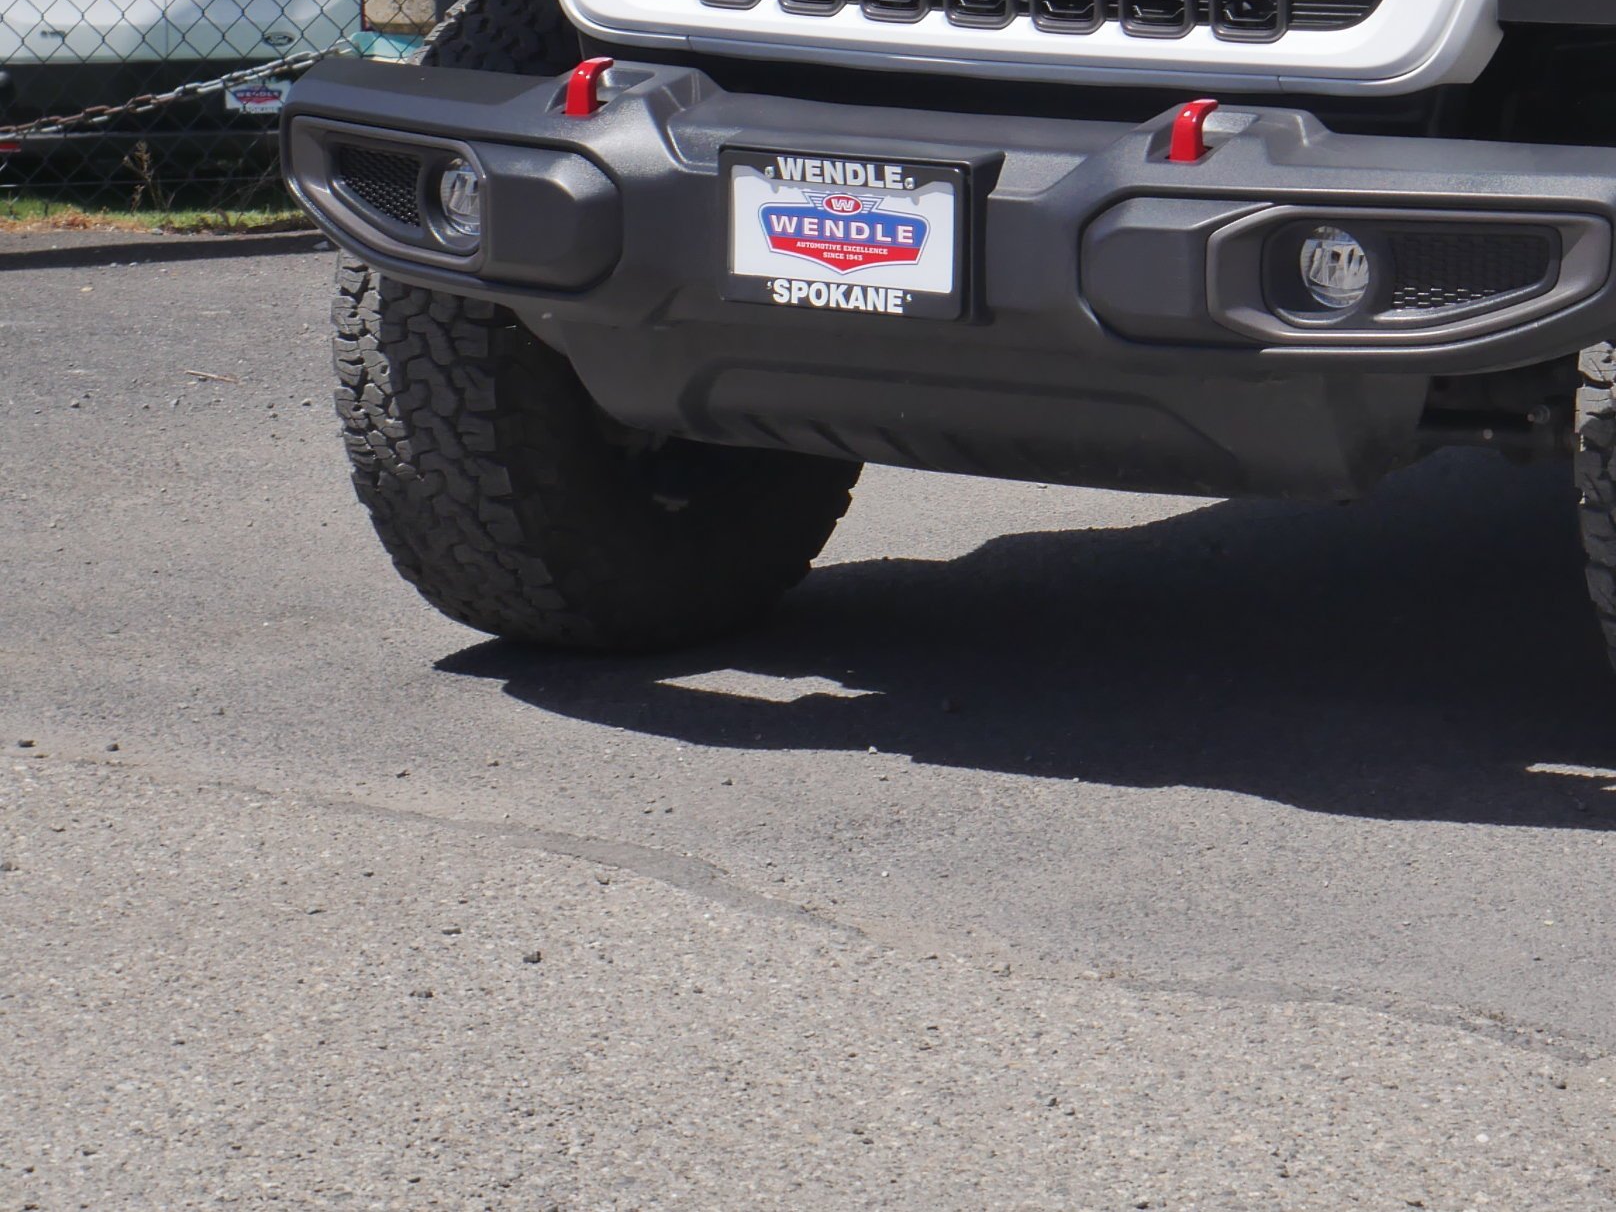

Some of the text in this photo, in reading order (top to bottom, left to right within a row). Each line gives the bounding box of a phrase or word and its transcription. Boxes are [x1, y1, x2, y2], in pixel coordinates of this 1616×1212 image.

[777, 156, 904, 190] WENDLE
[770, 214, 914, 244] WENDLE
[796, 241, 889, 255] AUTOMOTIVE EXCELLENCE
[823, 251, 845, 260] SINCE
[772, 279, 903, 314] SPOKANE
